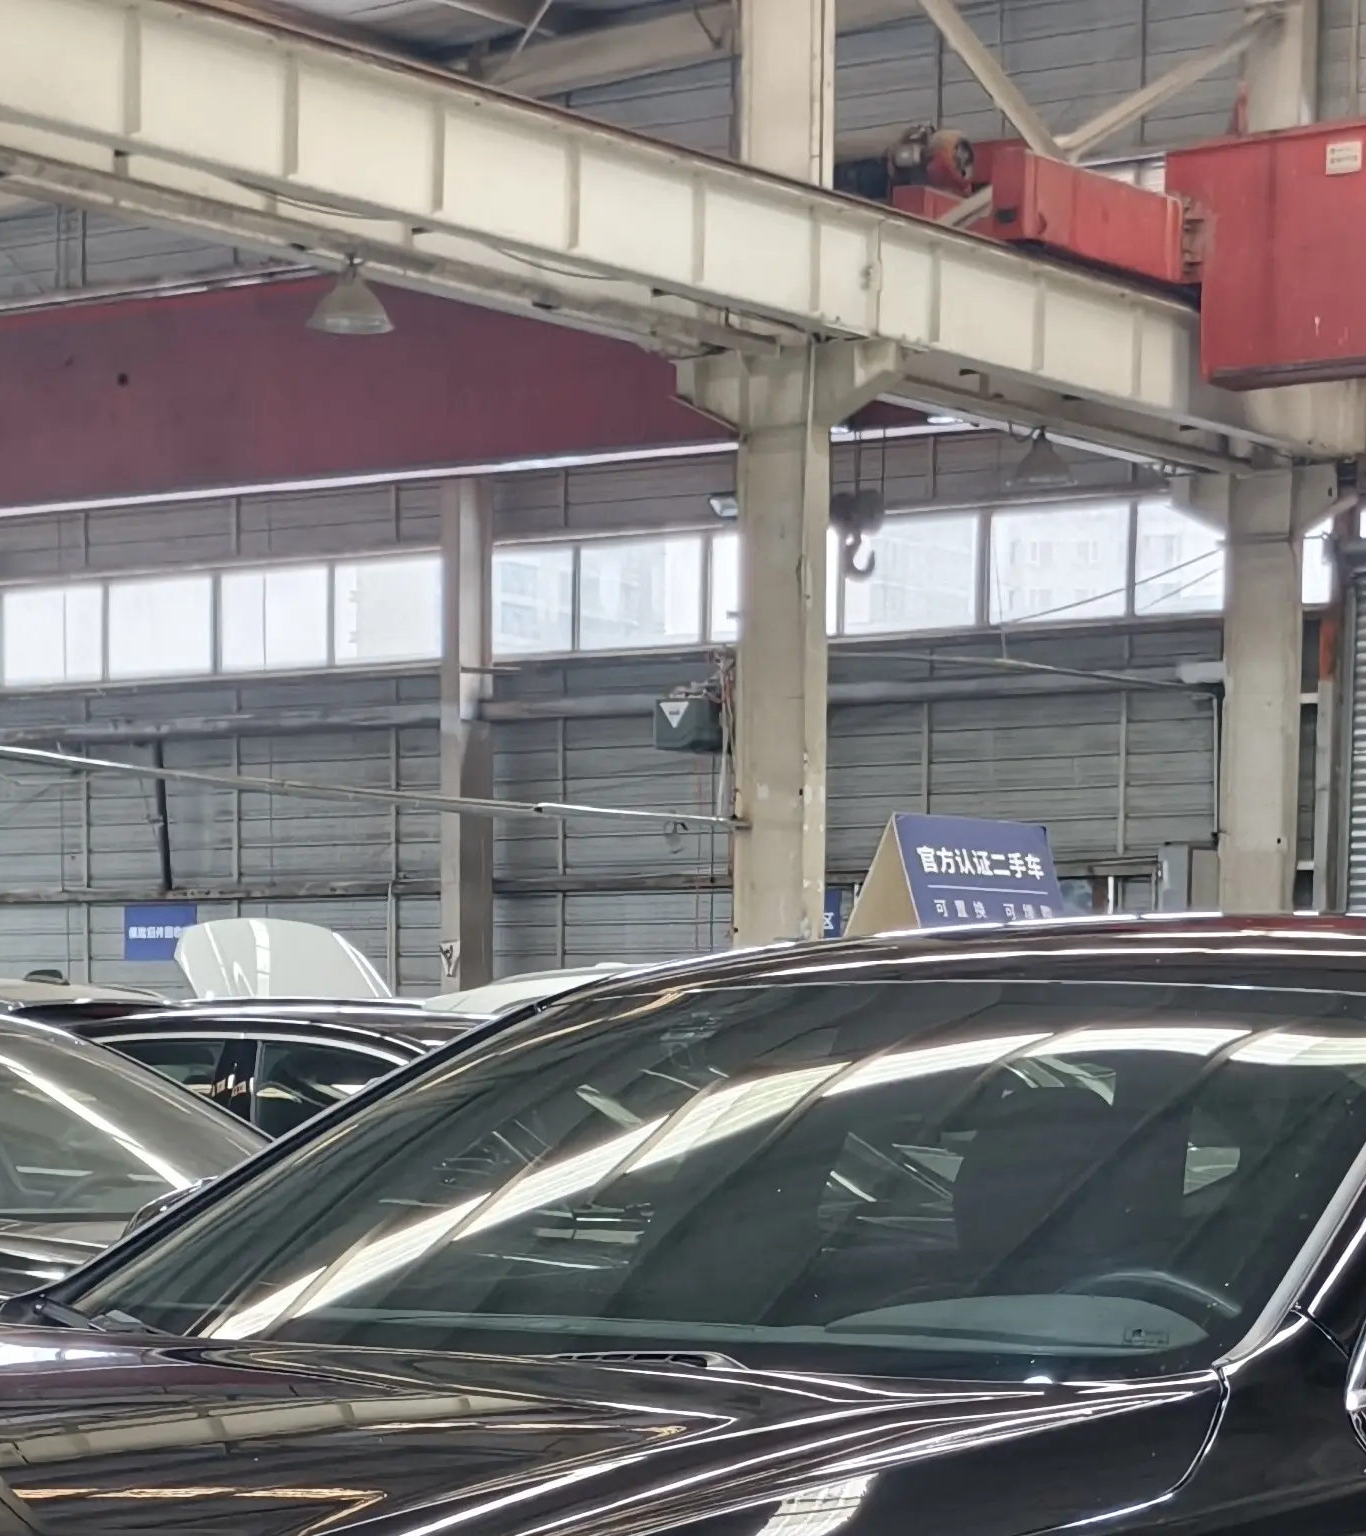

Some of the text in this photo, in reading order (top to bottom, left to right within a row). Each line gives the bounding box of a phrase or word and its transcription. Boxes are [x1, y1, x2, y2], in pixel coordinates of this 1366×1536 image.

[916, 846, 1045, 881] 官方认证二手车
